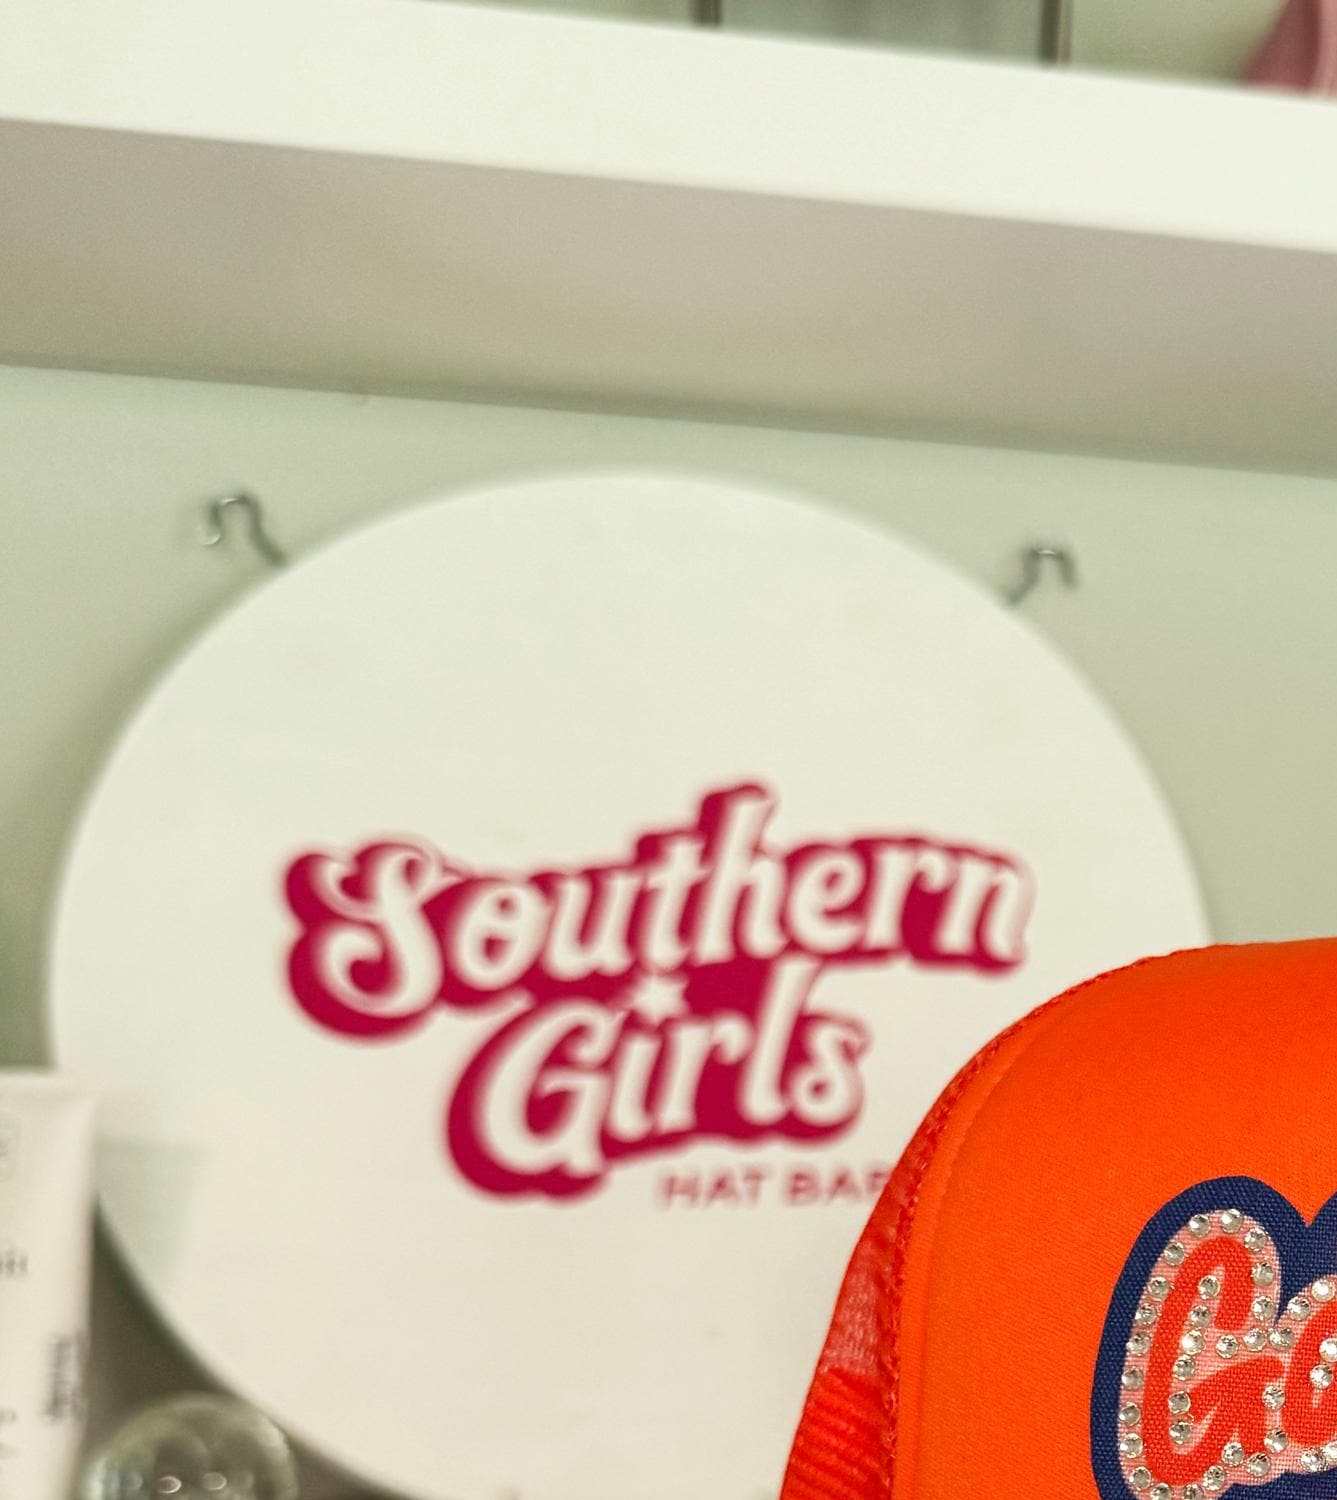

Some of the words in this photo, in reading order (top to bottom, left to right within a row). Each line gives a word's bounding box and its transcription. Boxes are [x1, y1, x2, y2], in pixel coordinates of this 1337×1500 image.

[287, 782, 1030, 1038] Southern
[448, 962, 870, 1204] Girls
[660, 1163, 770, 1207] HAT
